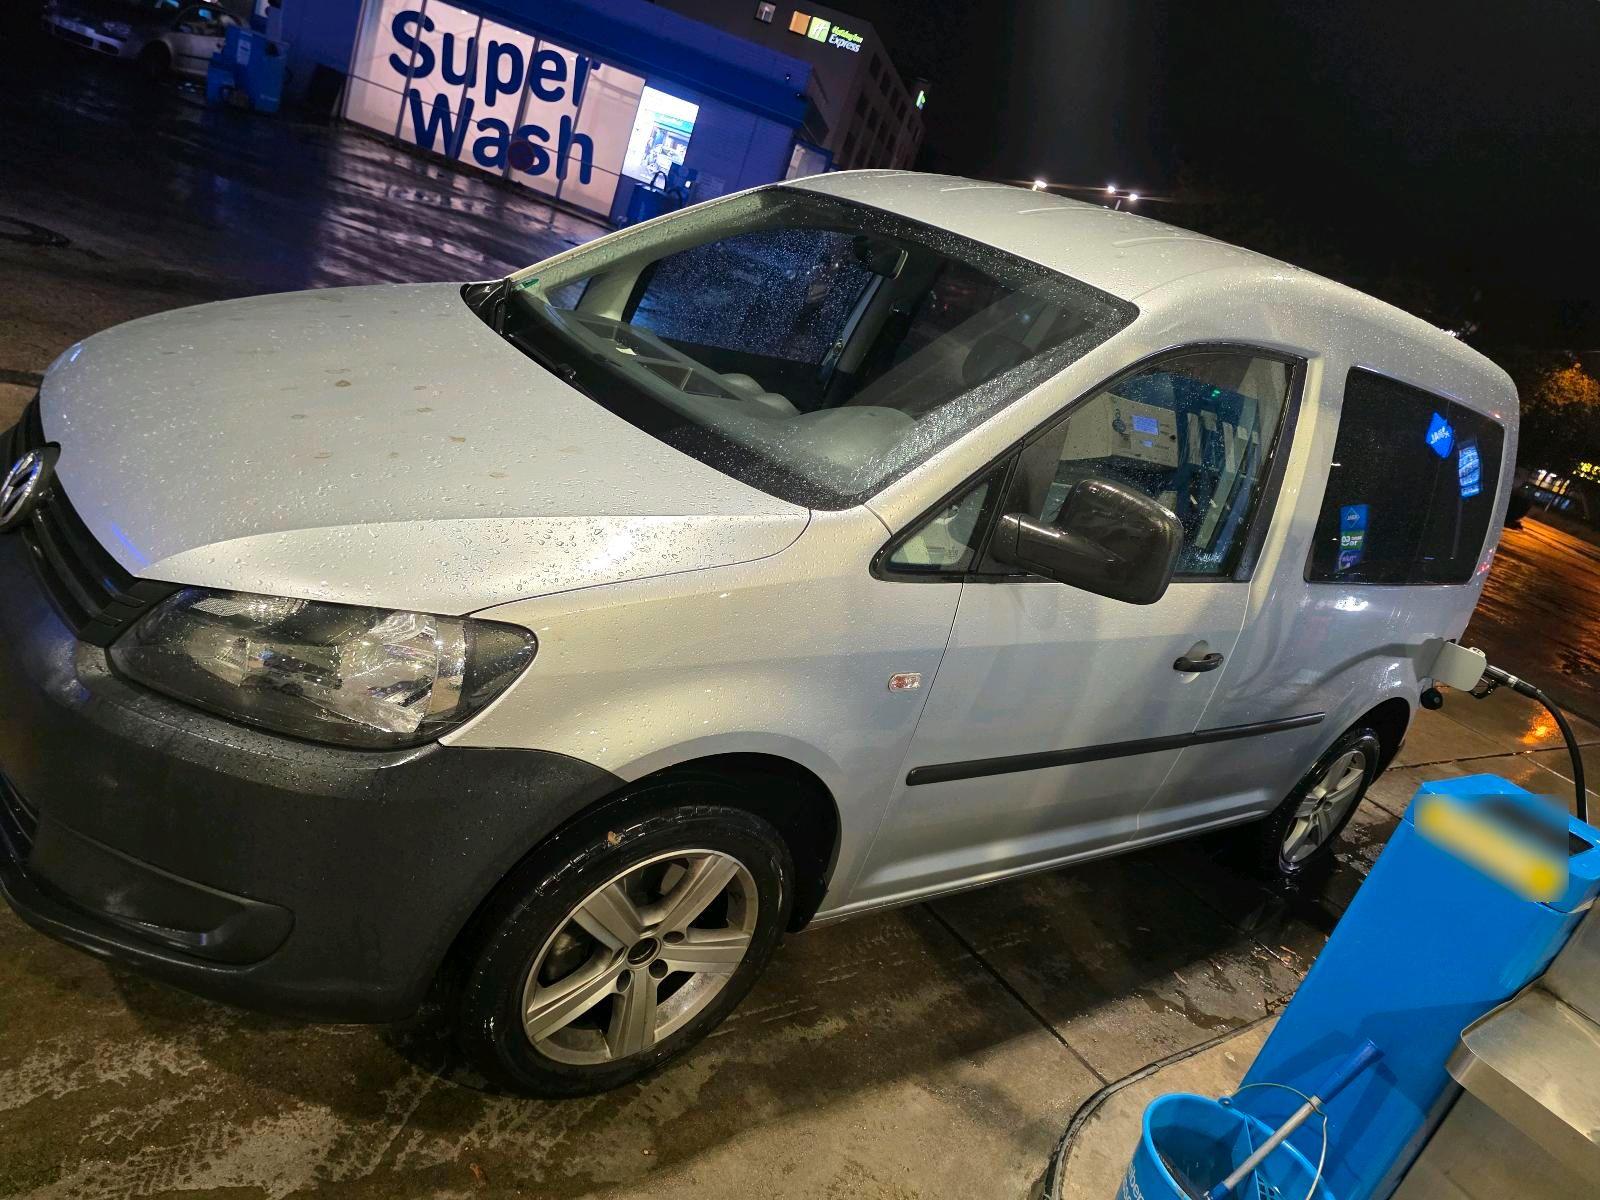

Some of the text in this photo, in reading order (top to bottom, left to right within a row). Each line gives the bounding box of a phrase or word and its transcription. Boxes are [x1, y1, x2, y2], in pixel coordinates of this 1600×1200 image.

[389, 10, 600, 107] Super
[828, 34, 861, 52] Express
[406, 88, 594, 185] Wash
